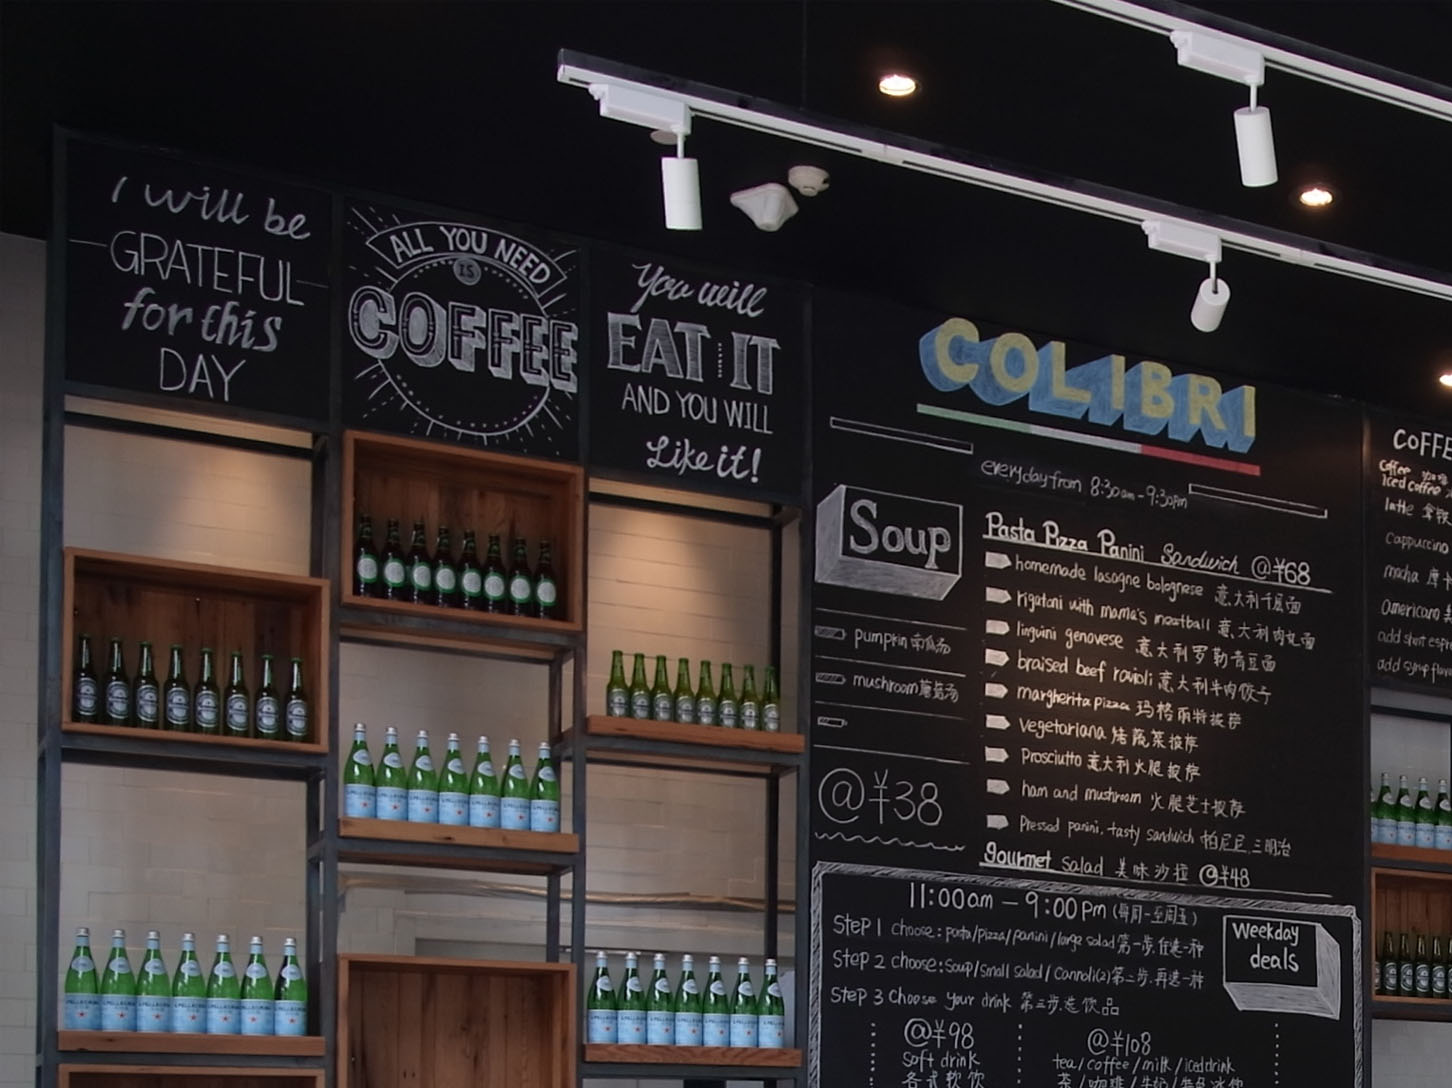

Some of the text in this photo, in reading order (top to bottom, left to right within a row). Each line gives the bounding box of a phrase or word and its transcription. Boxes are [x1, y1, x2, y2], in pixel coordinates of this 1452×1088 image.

[144, 179, 249, 225] will
[264, 195, 310, 240] be
[111, 231, 304, 306] GRATEFUL
[391, 225, 551, 285] ALL YOU NEED
[458, 262, 476, 278] IS
[632, 262, 769, 318] You will
[122, 287, 282, 352] for this
[349, 286, 578, 393] COFFEE
[607, 312, 780, 395] EAT IT
[159, 348, 246, 401] DAY
[919, 316, 1255, 453] COLIBRI
[622, 382, 772, 434] AND YOU WILL
[647, 436, 711, 474] Like
[1049, 471, 1082, 492] from
[850, 499, 950, 570] Soup
[985, 512, 1035, 543] Pasta
[1043, 520, 1088, 551] Pizza
[1097, 529, 1144, 562] Panini
[1161, 543, 1240, 575] Sandwich
[1015, 554, 1086, 581] homemade
[1094, 566, 1140, 592] lasagne
[1147, 572, 1203, 602] bolognese
[1017, 590, 1063, 612] rigatoni
[1069, 597, 1094, 616] with
[854, 628, 907, 651] pumpkin
[1065, 627, 1124, 650] genovese
[853, 674, 919, 696] mushroom
[1017, 651, 1069, 675] braised
[1076, 659, 1105, 683] beef
[1113, 666, 1153, 687] ravioli
[1094, 695, 1130, 711] pizza
[1021, 780, 1048, 799] ham
[1054, 785, 1078, 801] and
[1085, 787, 1142, 804] mushroom
[1108, 821, 1140, 846] tasty
[1232, 920, 1299, 947] Weekday
[875, 954, 886, 969] 2
[1250, 944, 1299, 972] deals
[875, 988, 884, 1005] 3
[981, 992, 1012, 1013] drink
[940, 1050, 980, 1068] drink
